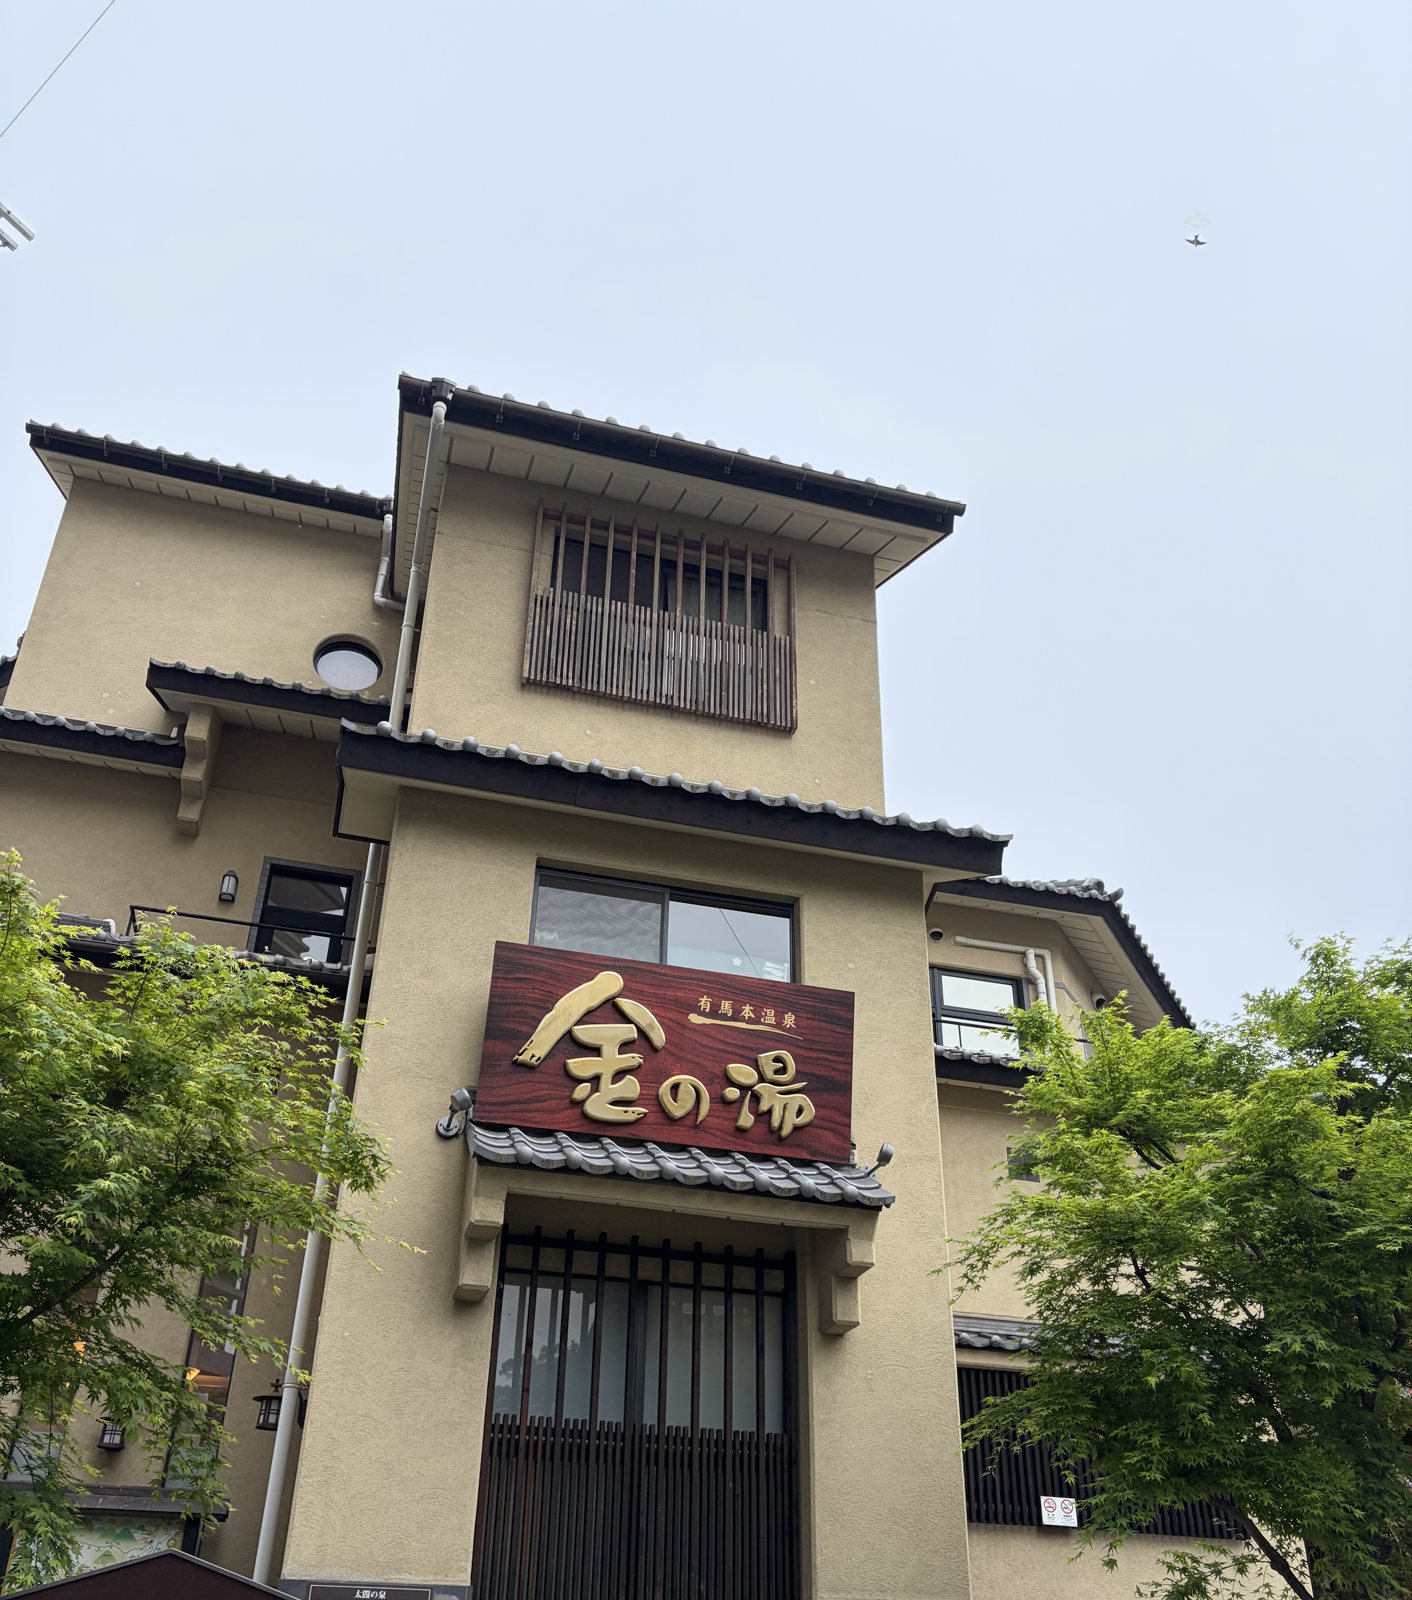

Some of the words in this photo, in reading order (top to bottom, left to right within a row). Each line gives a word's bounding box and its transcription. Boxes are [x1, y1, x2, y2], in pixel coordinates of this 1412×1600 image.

[512, 971, 816, 1138] 金の湯
[698, 995, 797, 1028] 有馬本温泉
